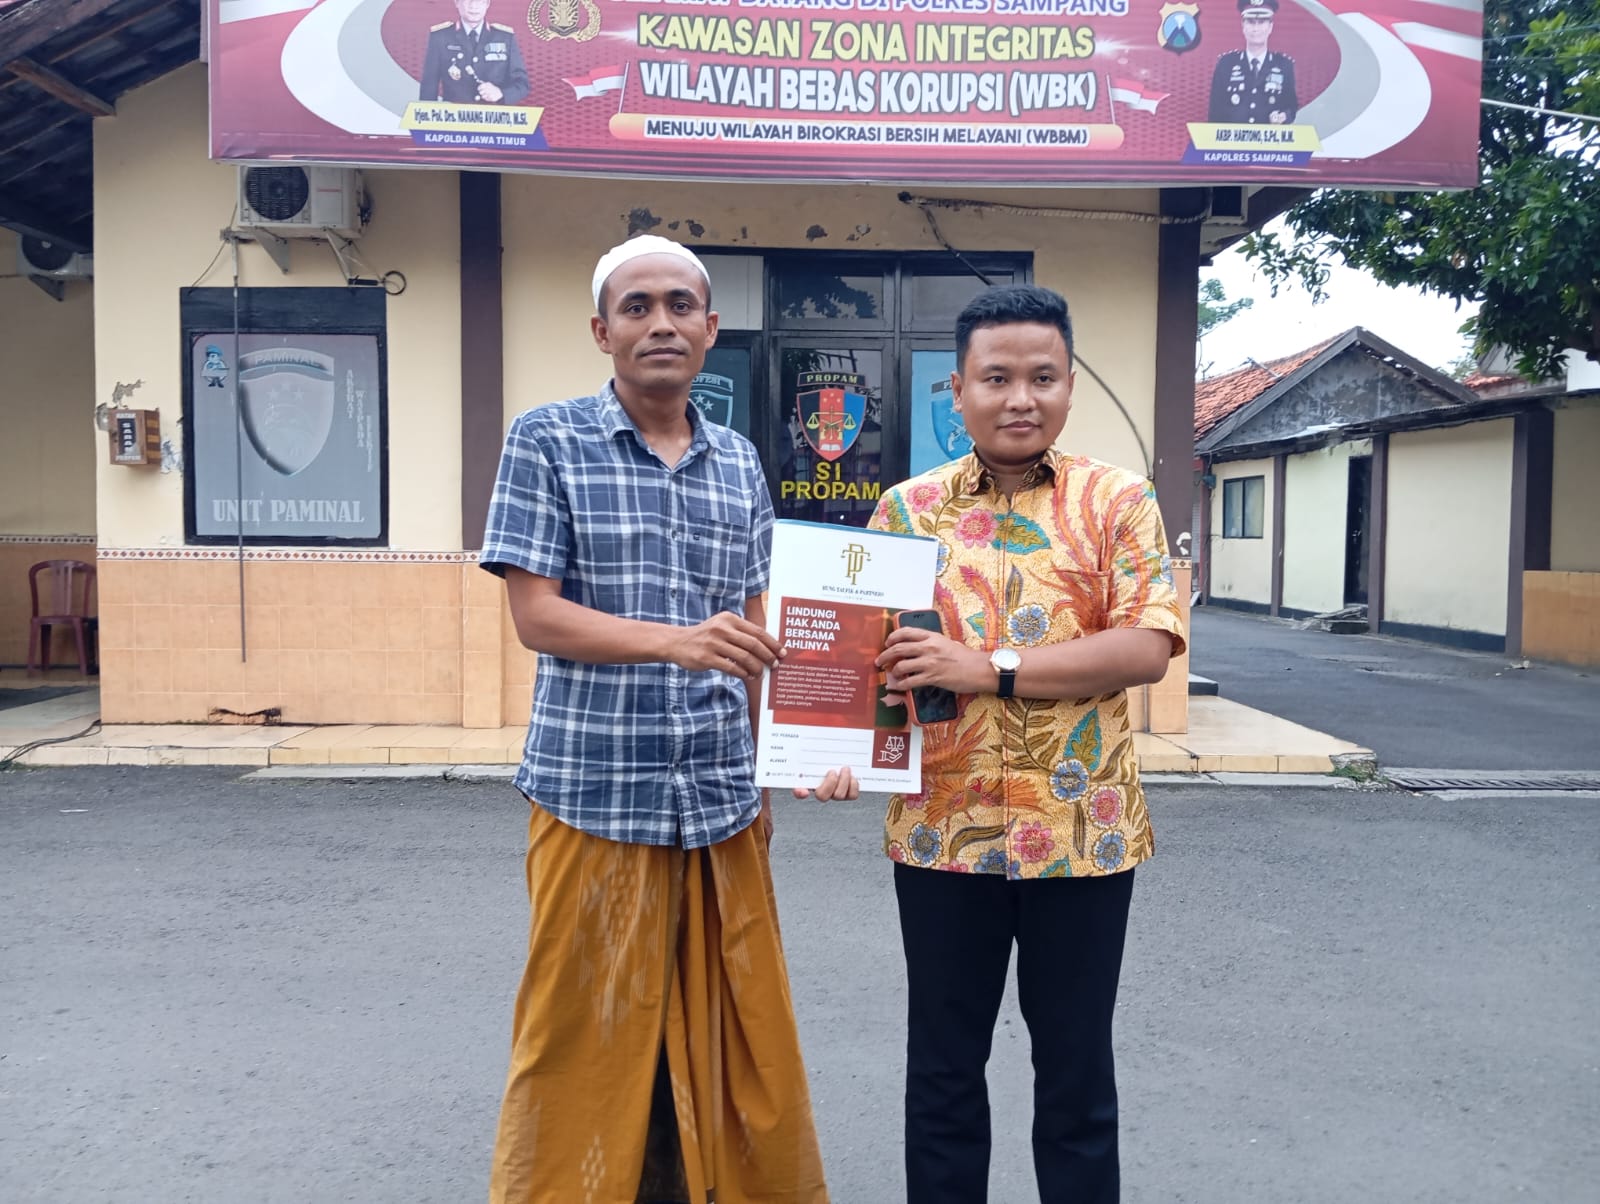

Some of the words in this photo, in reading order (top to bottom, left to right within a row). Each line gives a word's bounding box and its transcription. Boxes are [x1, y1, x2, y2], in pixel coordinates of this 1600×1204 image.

[639, 14, 800, 58] KAWASAN
[811, 21, 907, 61] ZONA
[916, 24, 1094, 61] INTEGRITAS
[640, 61, 774, 107] WILAYAH
[780, 68, 876, 113] BEBAS
[880, 71, 1003, 114] KORUPSI
[1009, 71, 1097, 116] (WBK)
[647, 119, 717, 137] MENUJU
[721, 122, 793, 140] WILAYAH
[798, 125, 881, 142] BIROKRASI
[886, 127, 939, 142] BERSIH
[943, 128, 1021, 144] MELAYANI
[1026, 129, 1088, 145] (WBBM)
[425, 133, 468, 144] KAPOLDA
[469, 135, 495, 145] JAWA
[496, 136, 527, 146] TIMUR
[1204, 152, 1250, 163] KAPOLRES
[1251, 153, 1294, 163] SAMPANG
[806, 373, 858, 384] PROPAM
[816, 461, 841, 481] SI
[780, 481, 881, 500] PROPAM
[213, 499, 264, 522] UNIT
[271, 500, 365, 523] PAMINAL
[786, 606, 836, 619] LINDUNGI
[786, 617, 809, 628] HAK
[811, 618, 840, 630] ANDA
[785, 628, 835, 641] BERSAMA
[784, 639, 830, 651] AHLINYA
